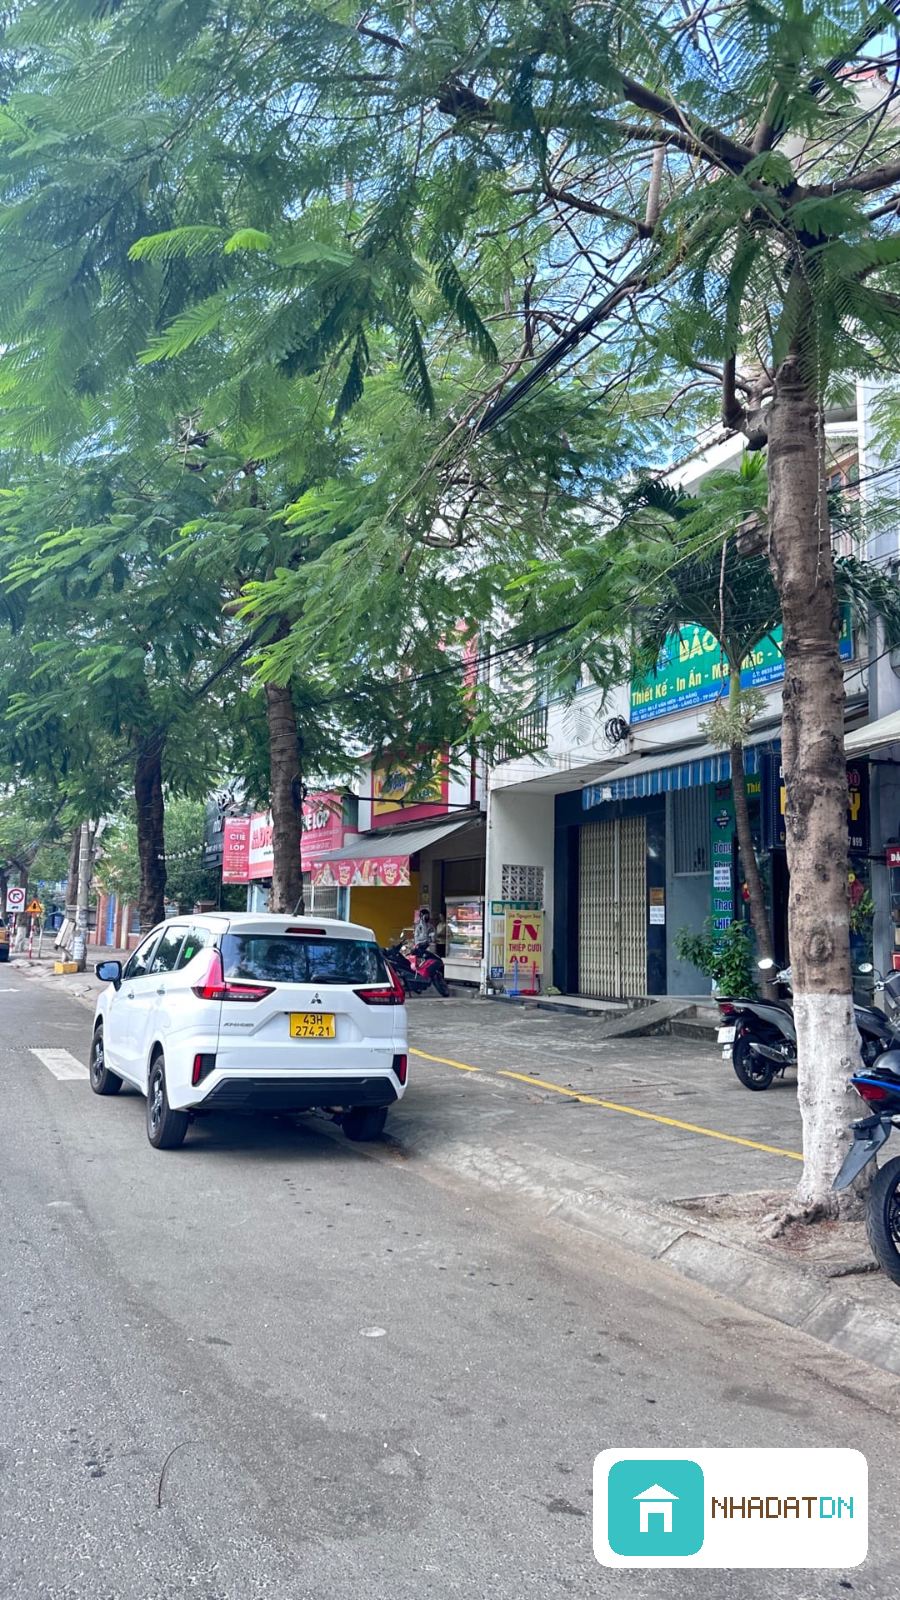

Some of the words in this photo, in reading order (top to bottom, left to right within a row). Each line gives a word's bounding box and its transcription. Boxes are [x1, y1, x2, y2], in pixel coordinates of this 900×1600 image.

[632, 685, 653, 706] Thiết
[655, 678, 669, 699] Kế
[676, 677, 686, 691] In
[688, 666, 702, 688] Ấn
[712, 662, 731, 681] Ma
[303, 1014, 323, 1025] 43H
[295, 1026, 330, 1037] 274.21
